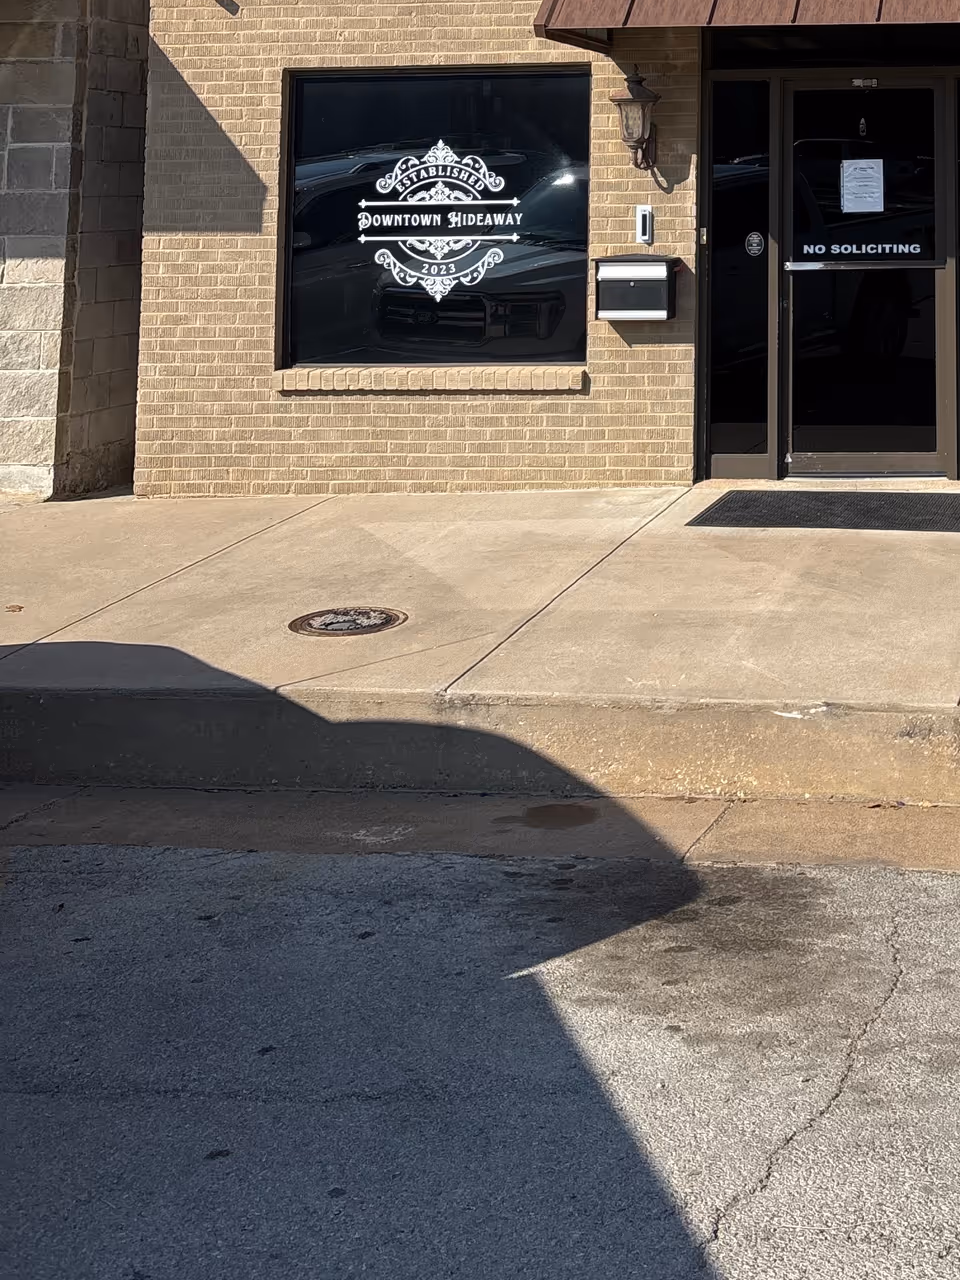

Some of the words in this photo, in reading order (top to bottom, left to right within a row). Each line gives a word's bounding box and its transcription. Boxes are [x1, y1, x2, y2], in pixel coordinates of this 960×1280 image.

[395, 166, 485, 193] ESTABLISHED
[357, 212, 441, 231] DOWNTOWN
[447, 212, 524, 229] HIDEAWAY
[803, 244, 826, 254] NO
[830, 243, 921, 254] SOLICITING
[421, 263, 456, 275] 2023
